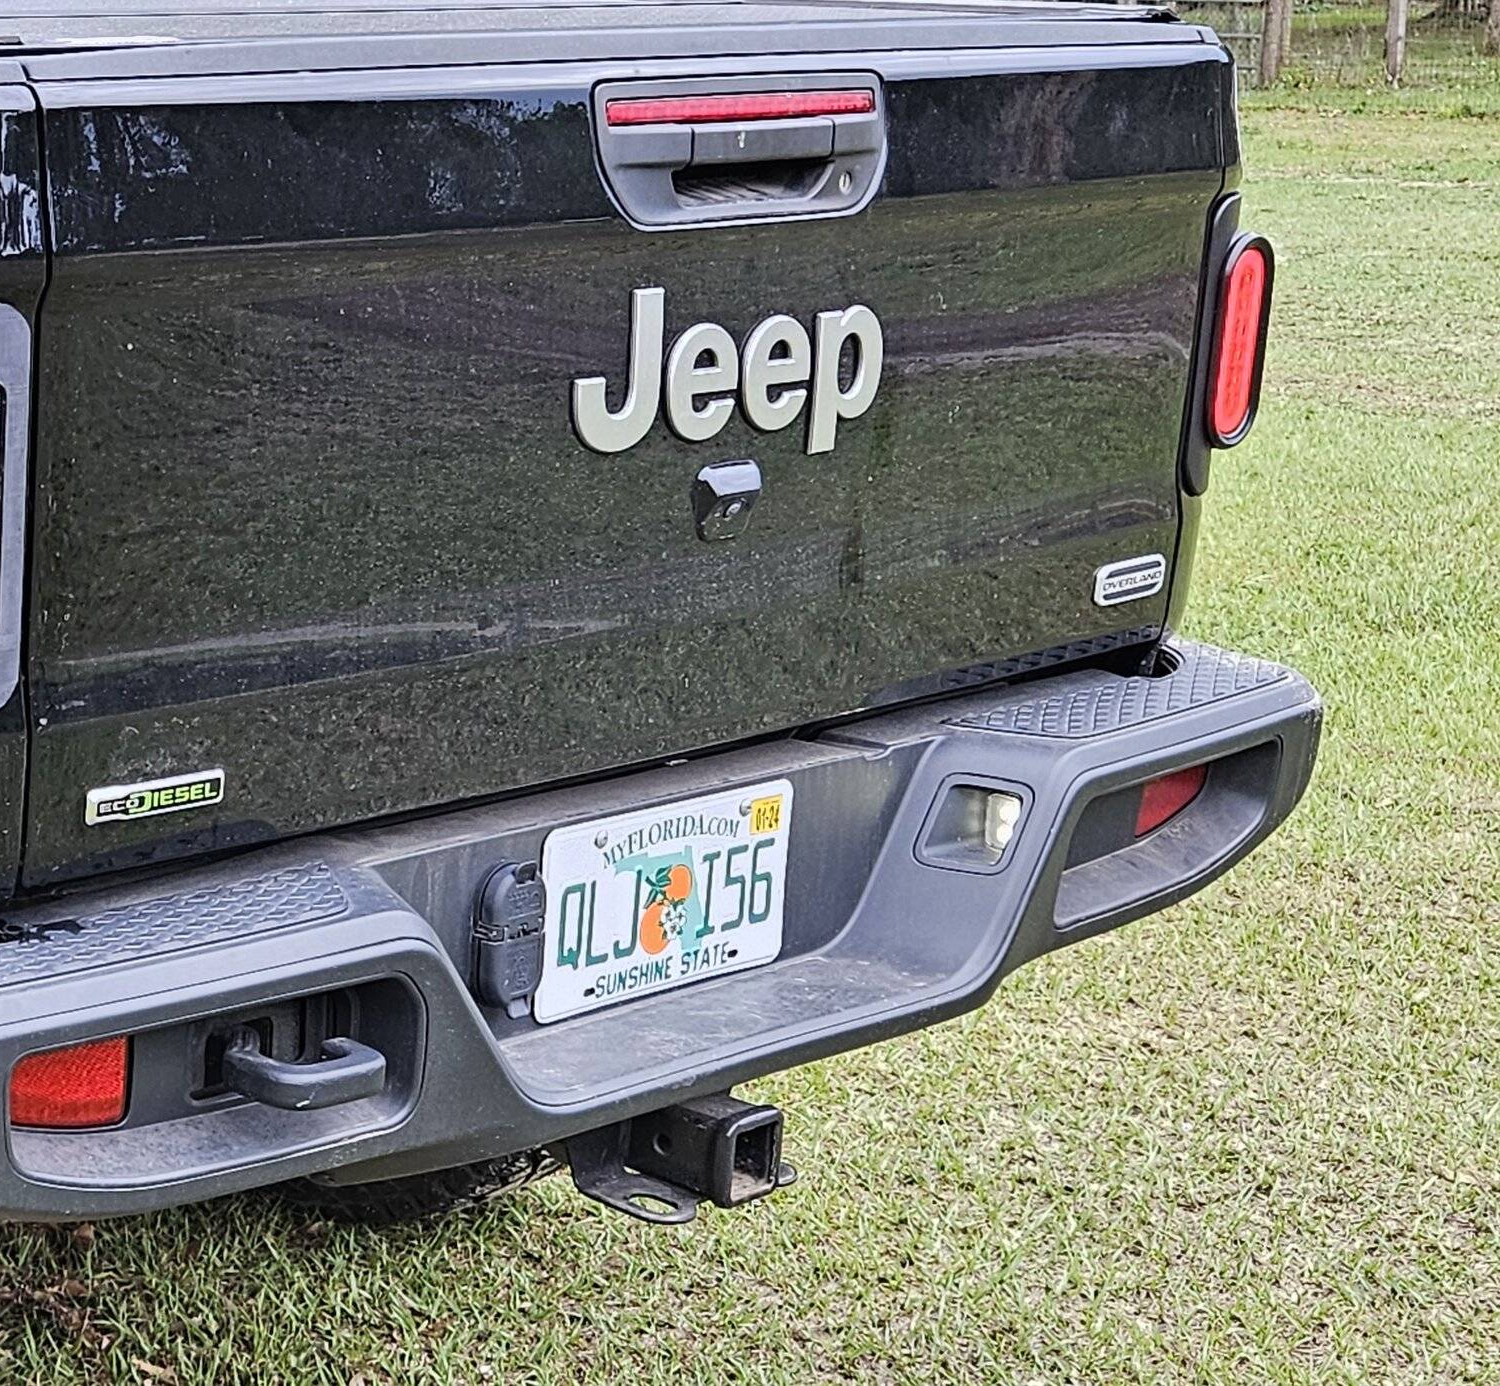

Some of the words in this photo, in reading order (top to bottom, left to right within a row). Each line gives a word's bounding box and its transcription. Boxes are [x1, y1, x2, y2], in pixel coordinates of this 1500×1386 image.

[573, 287, 884, 456] Jeep
[1103, 570, 1162, 591] OVERLAND
[557, 868, 643, 970] QLJ
[595, 955, 673, 998] SUNSHINE
[680, 941, 730, 976] STATE
